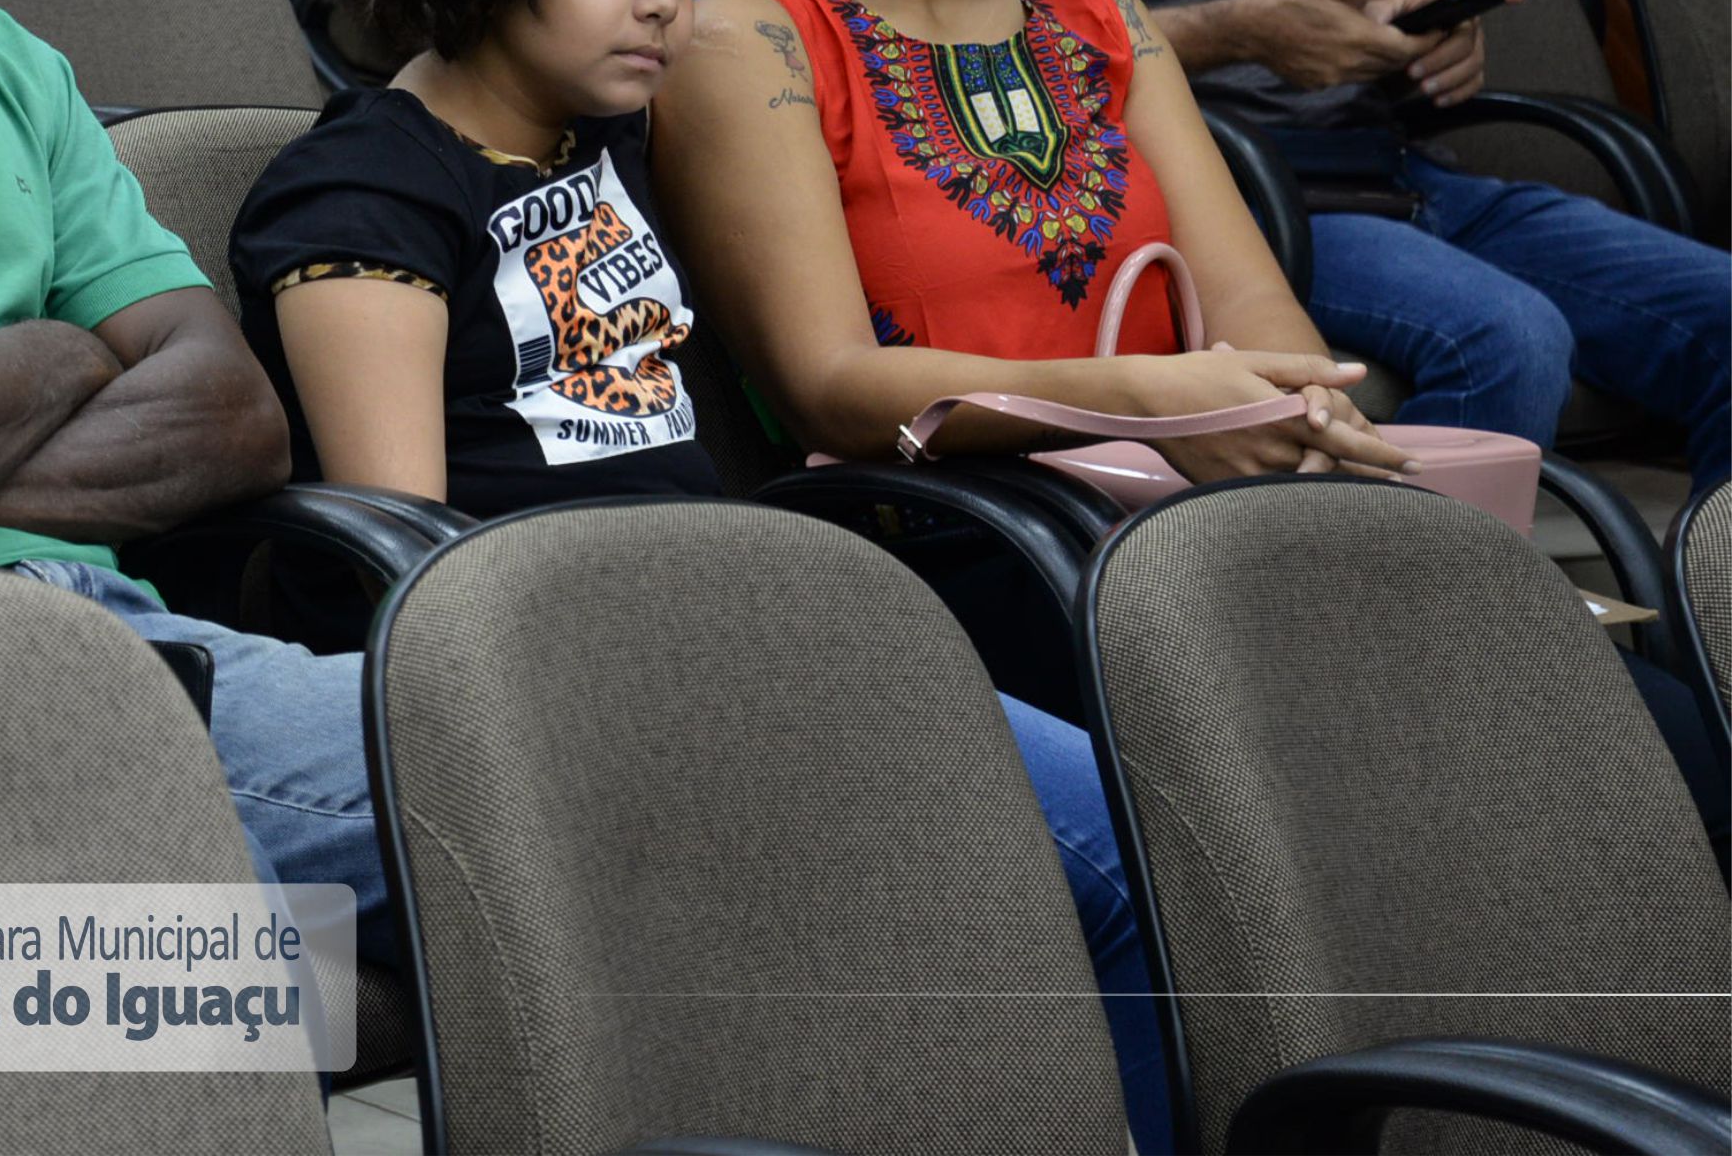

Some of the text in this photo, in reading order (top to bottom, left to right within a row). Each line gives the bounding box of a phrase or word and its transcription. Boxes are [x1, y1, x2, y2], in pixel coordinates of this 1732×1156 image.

[490, 174, 596, 254] GOOD
[579, 232, 664, 304] VIBES
[557, 418, 652, 446] SUMMER
